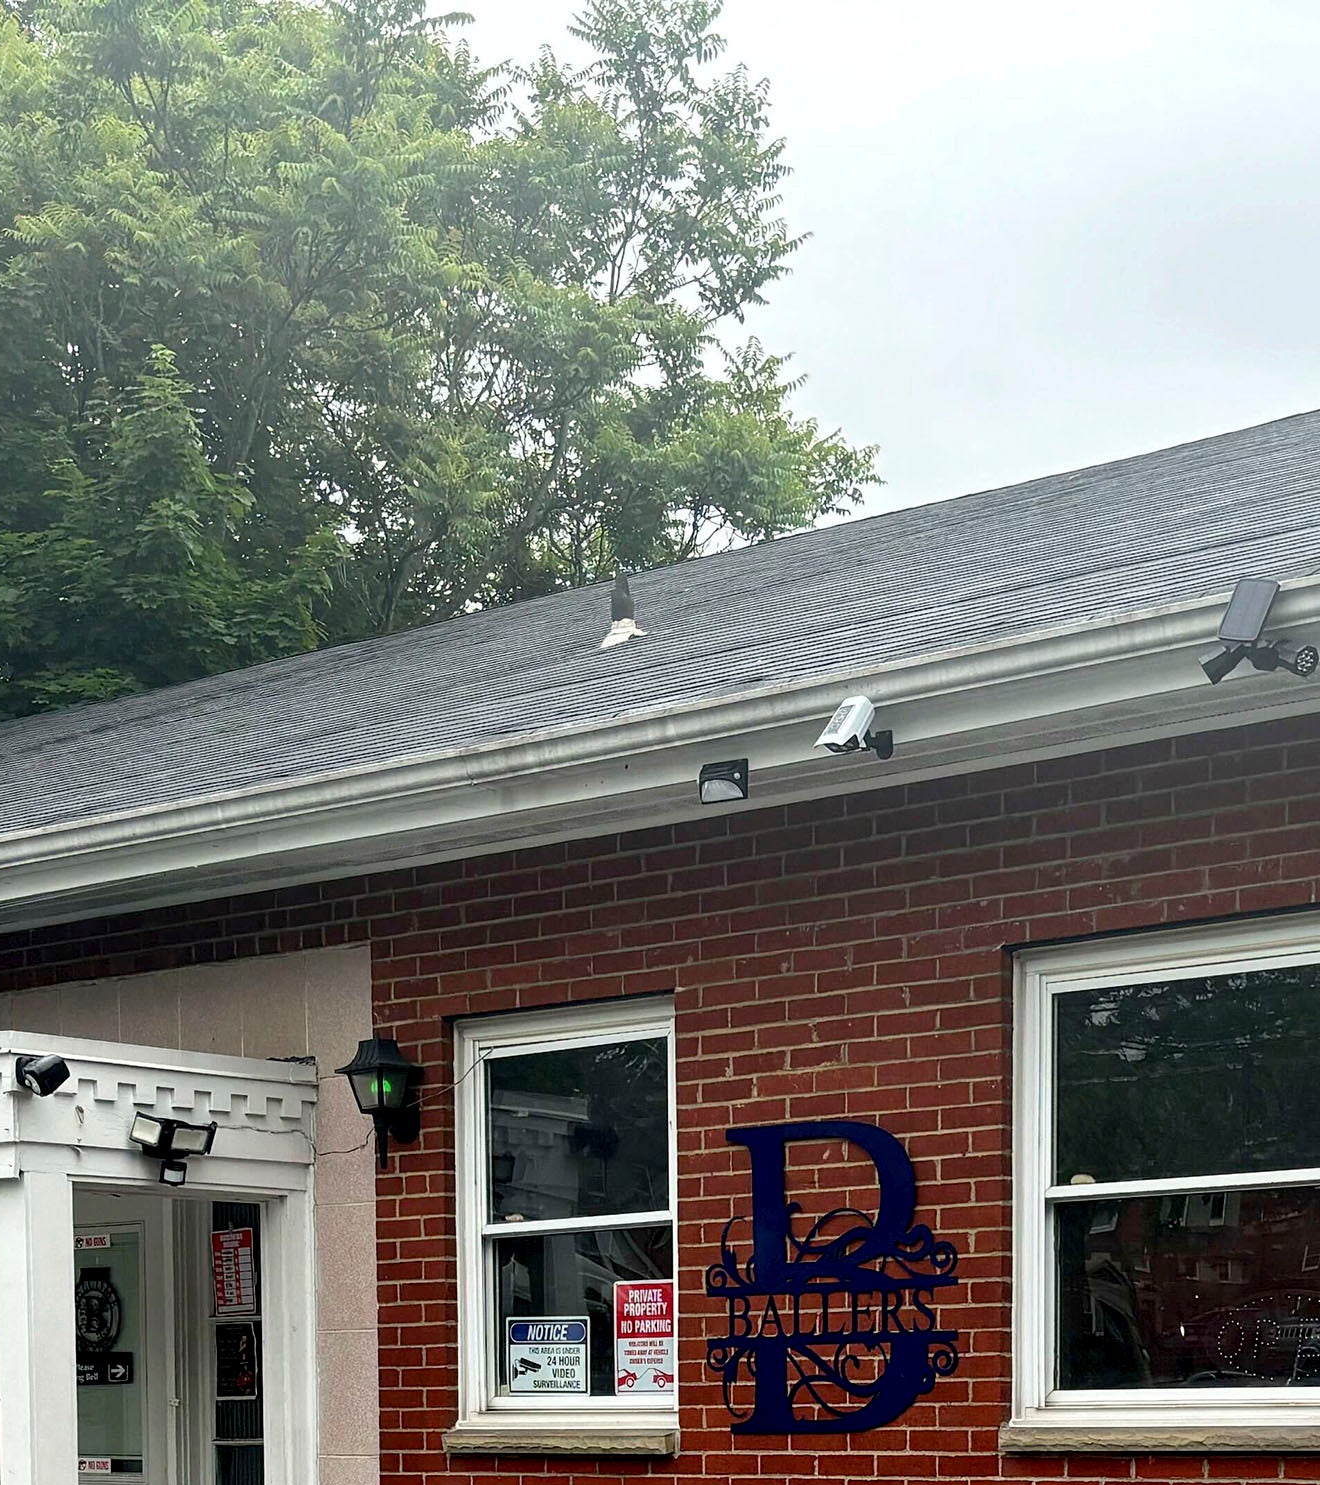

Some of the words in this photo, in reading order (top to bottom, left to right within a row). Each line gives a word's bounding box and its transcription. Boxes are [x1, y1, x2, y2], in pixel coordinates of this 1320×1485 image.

[628, 1289, 663, 1303] PRIVATE
[624, 1302, 668, 1316] PROPERTY
[728, 1286, 938, 1339] BALLERS
[527, 1324, 568, 1341] NOTICE
[621, 1320, 633, 1334] NO
[634, 1319, 671, 1333] PARKING
[547, 1356, 557, 1366] 24
[558, 1356, 581, 1366] HOUR
[552, 1368, 576, 1378] VIDEO
[533, 1380, 581, 1389] SURVEILLANCE
